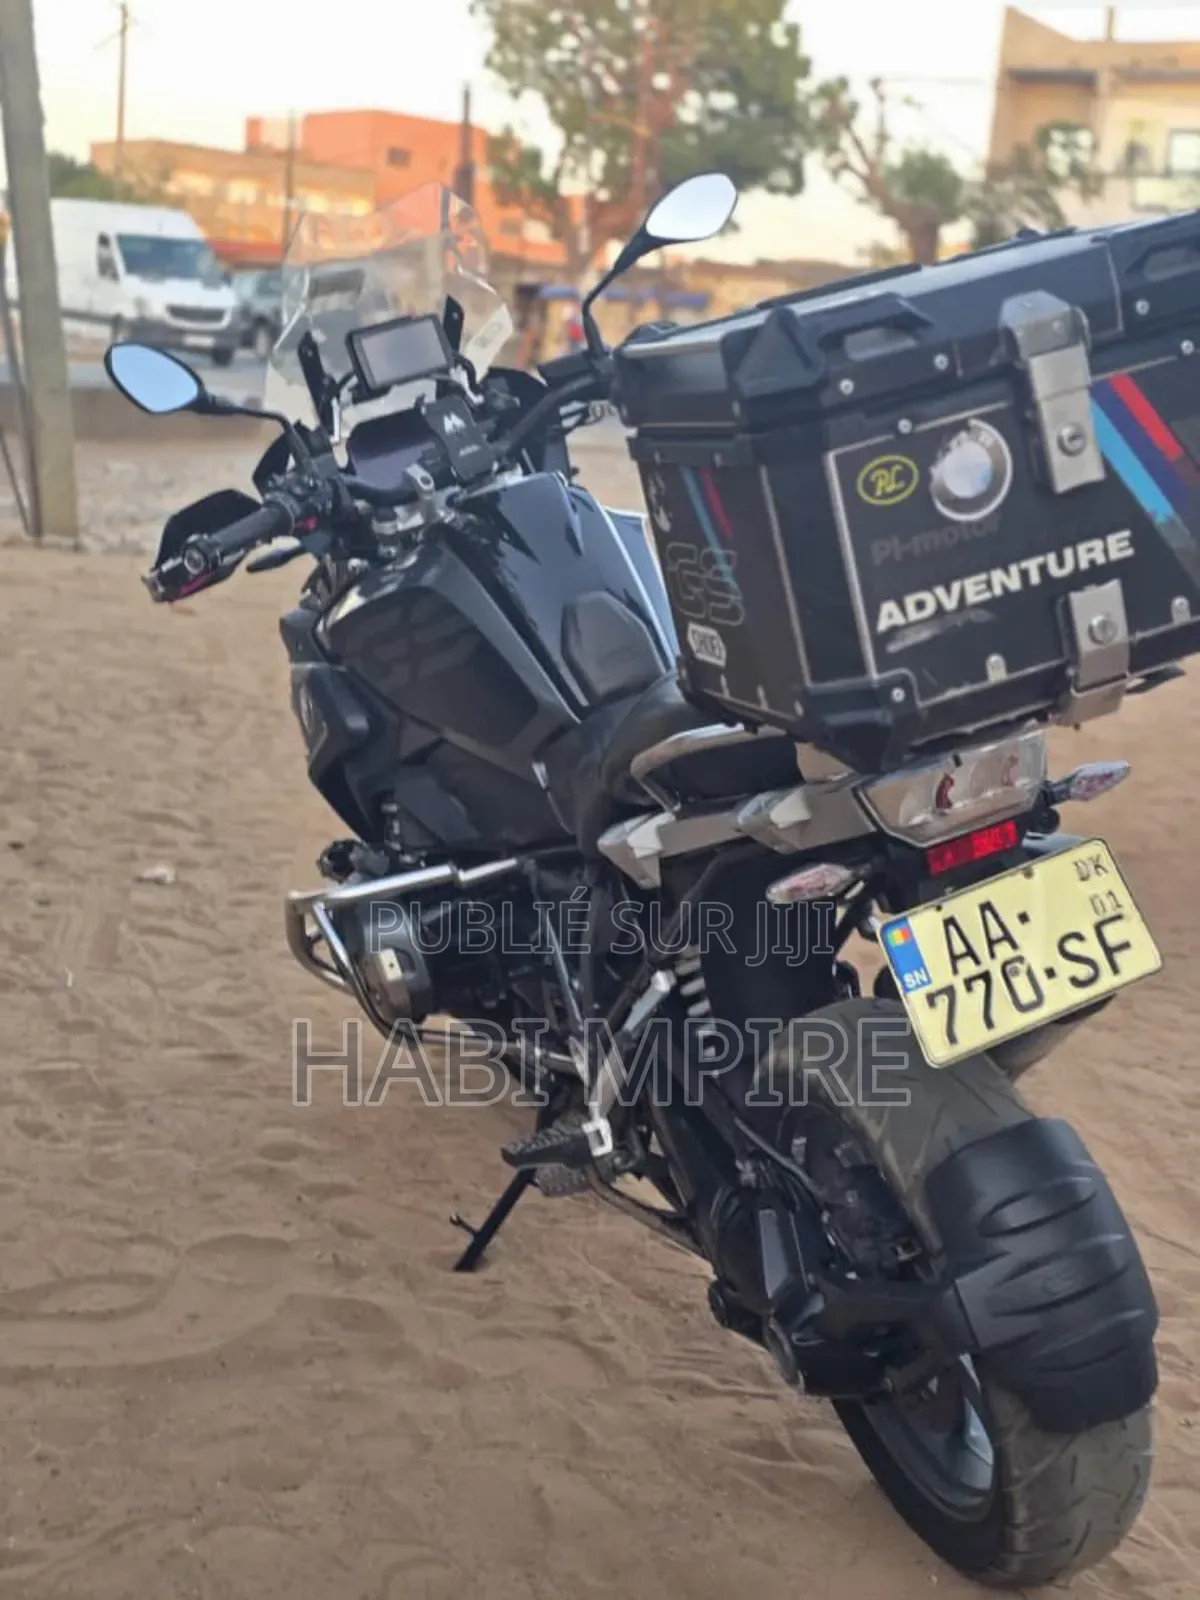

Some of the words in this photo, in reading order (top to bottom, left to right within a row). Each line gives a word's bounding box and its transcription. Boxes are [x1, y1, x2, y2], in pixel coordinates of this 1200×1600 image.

[875, 528, 1136, 635] ADVENTURE
[1072, 853, 1109, 882] DK
[1089, 890, 1124, 916] 01
[903, 967, 929, 989] SN
